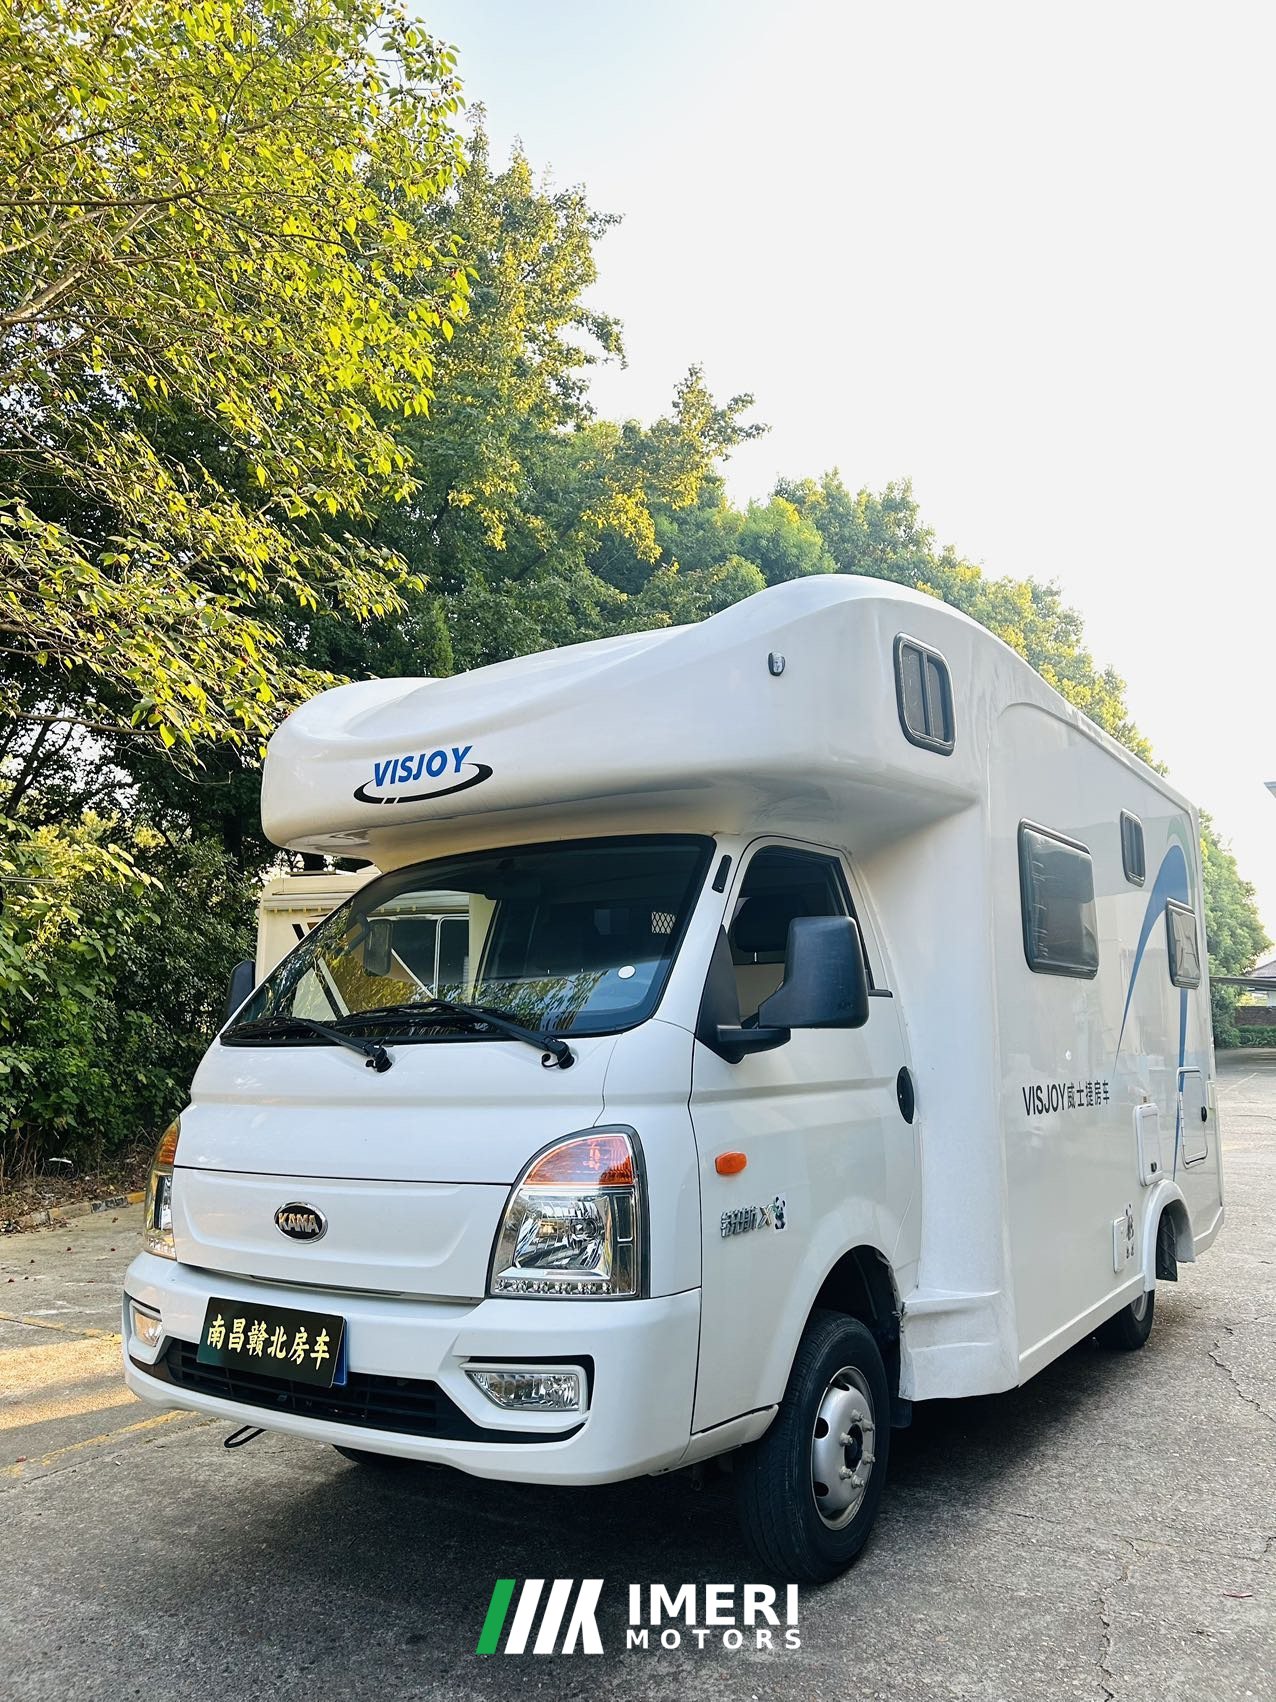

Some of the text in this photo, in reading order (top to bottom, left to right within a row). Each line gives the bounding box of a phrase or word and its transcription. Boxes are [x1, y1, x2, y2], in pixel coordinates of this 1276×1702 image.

[374, 745, 473, 788] VISJOY
[278, 1212, 320, 1233] KAMA
[207, 1313, 330, 1370] 南昌赣北房车
